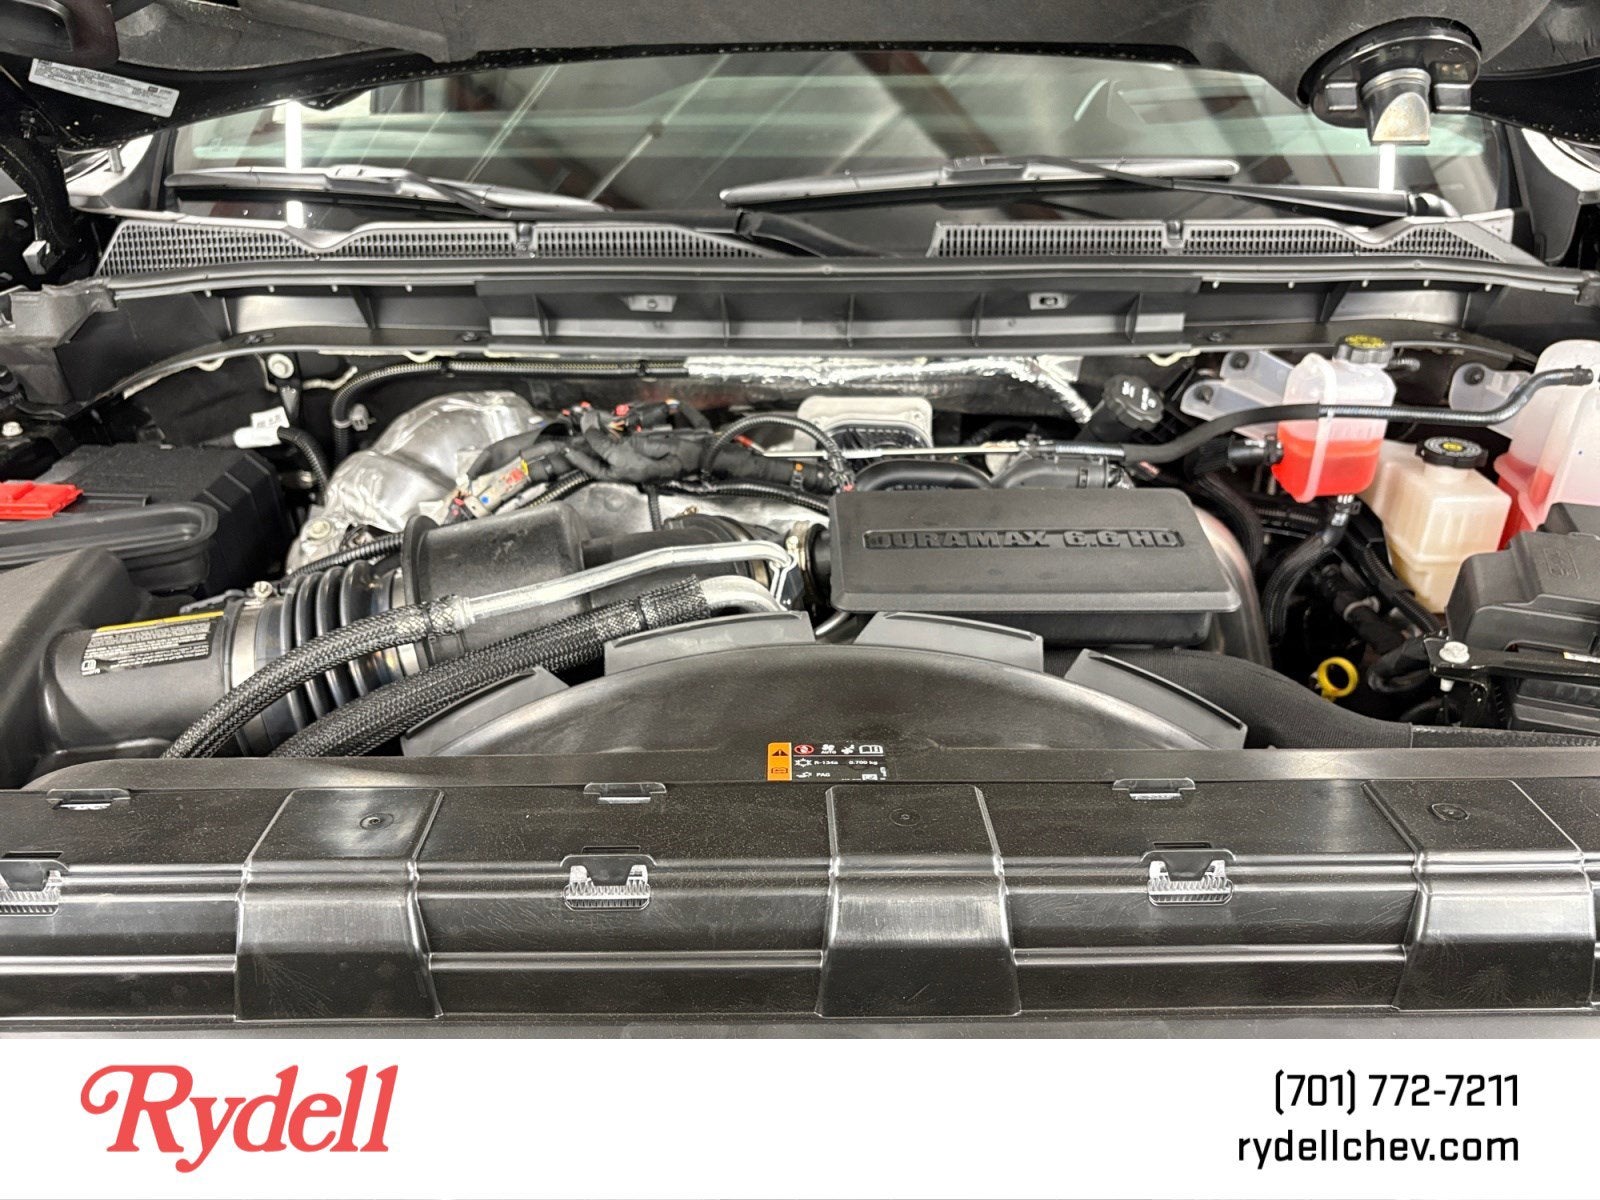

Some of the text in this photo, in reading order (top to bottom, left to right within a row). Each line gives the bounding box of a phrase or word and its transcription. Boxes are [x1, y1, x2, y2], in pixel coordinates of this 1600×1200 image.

[866, 530, 1184, 548] DURAMAX 6.6 HD
